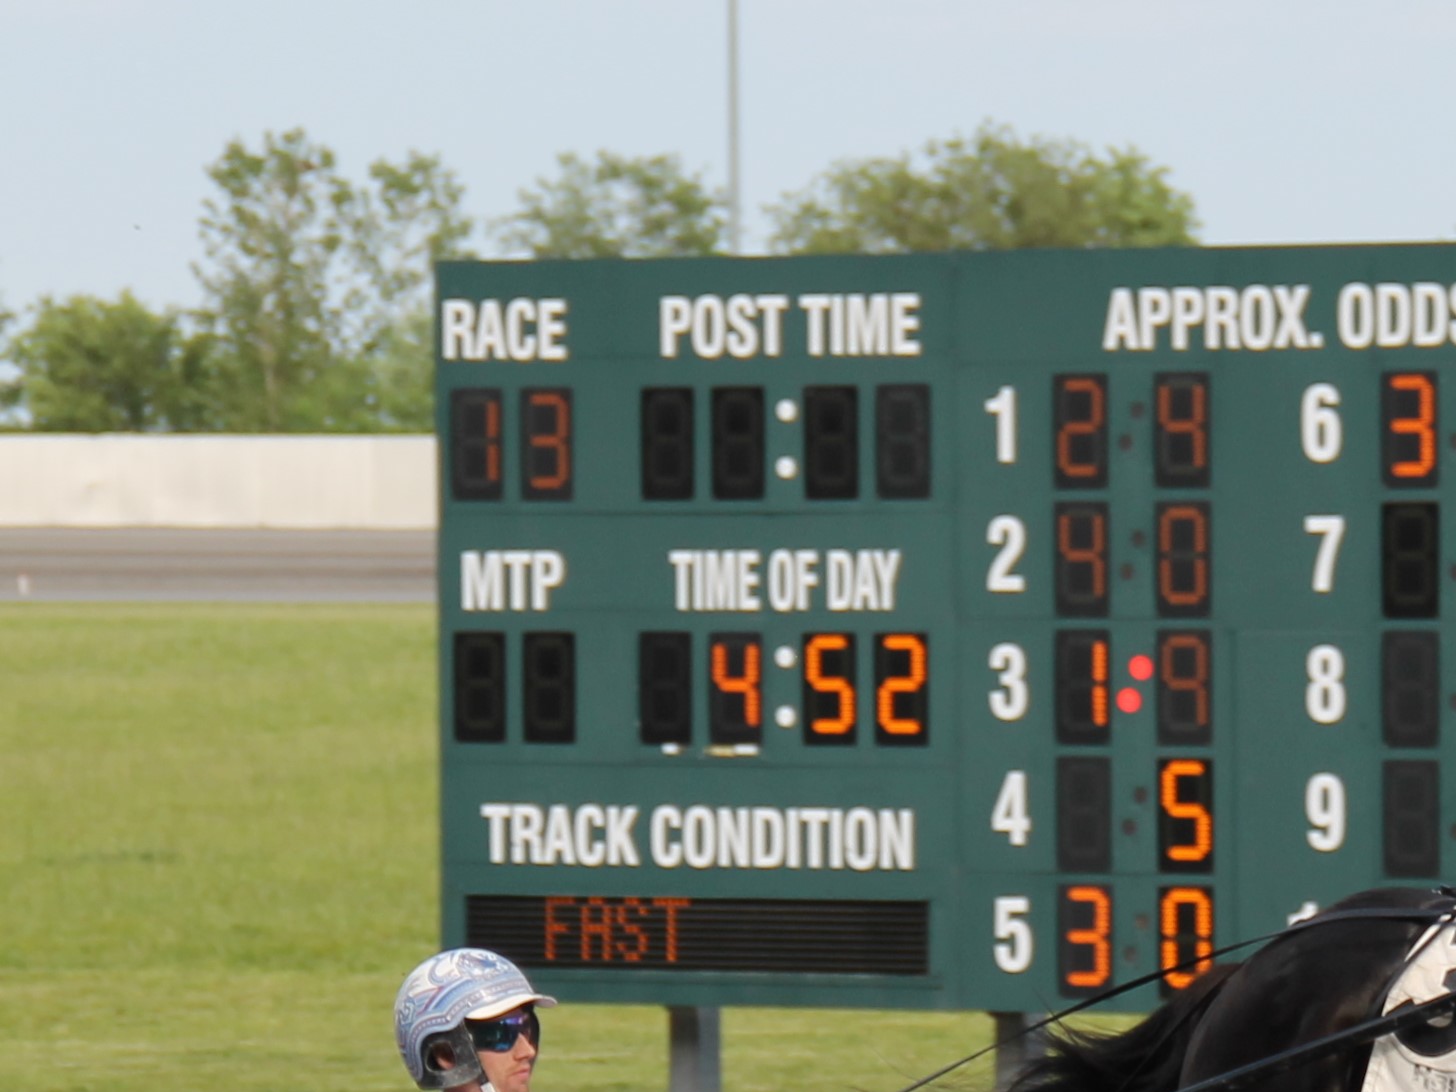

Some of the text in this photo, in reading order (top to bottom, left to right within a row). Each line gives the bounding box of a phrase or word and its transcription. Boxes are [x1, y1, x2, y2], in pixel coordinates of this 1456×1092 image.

[442, 297, 568, 360] RACE
[659, 293, 921, 357] POST TIME
[1102, 284, 1324, 350] APPROX.
[486, 393, 570, 489] 13
[984, 386, 1016, 463] 1
[1300, 383, 1342, 462] 6
[460, 550, 565, 611] MTP
[667, 549, 901, 612] TIME OF DAY
[985, 515, 1026, 592] 2
[1303, 515, 1345, 592] 7
[710, 633, 929, 736] 4:52
[987, 643, 1029, 721] 3
[1305, 644, 1346, 724] 8
[480, 803, 915, 870] TRACK CONDITION
[990, 770, 1031, 846] 4
[1159, 758, 1214, 862] 5
[1305, 772, 1346, 851] 9
[544, 895, 691, 963] FAST
[993, 896, 1033, 972] 5
